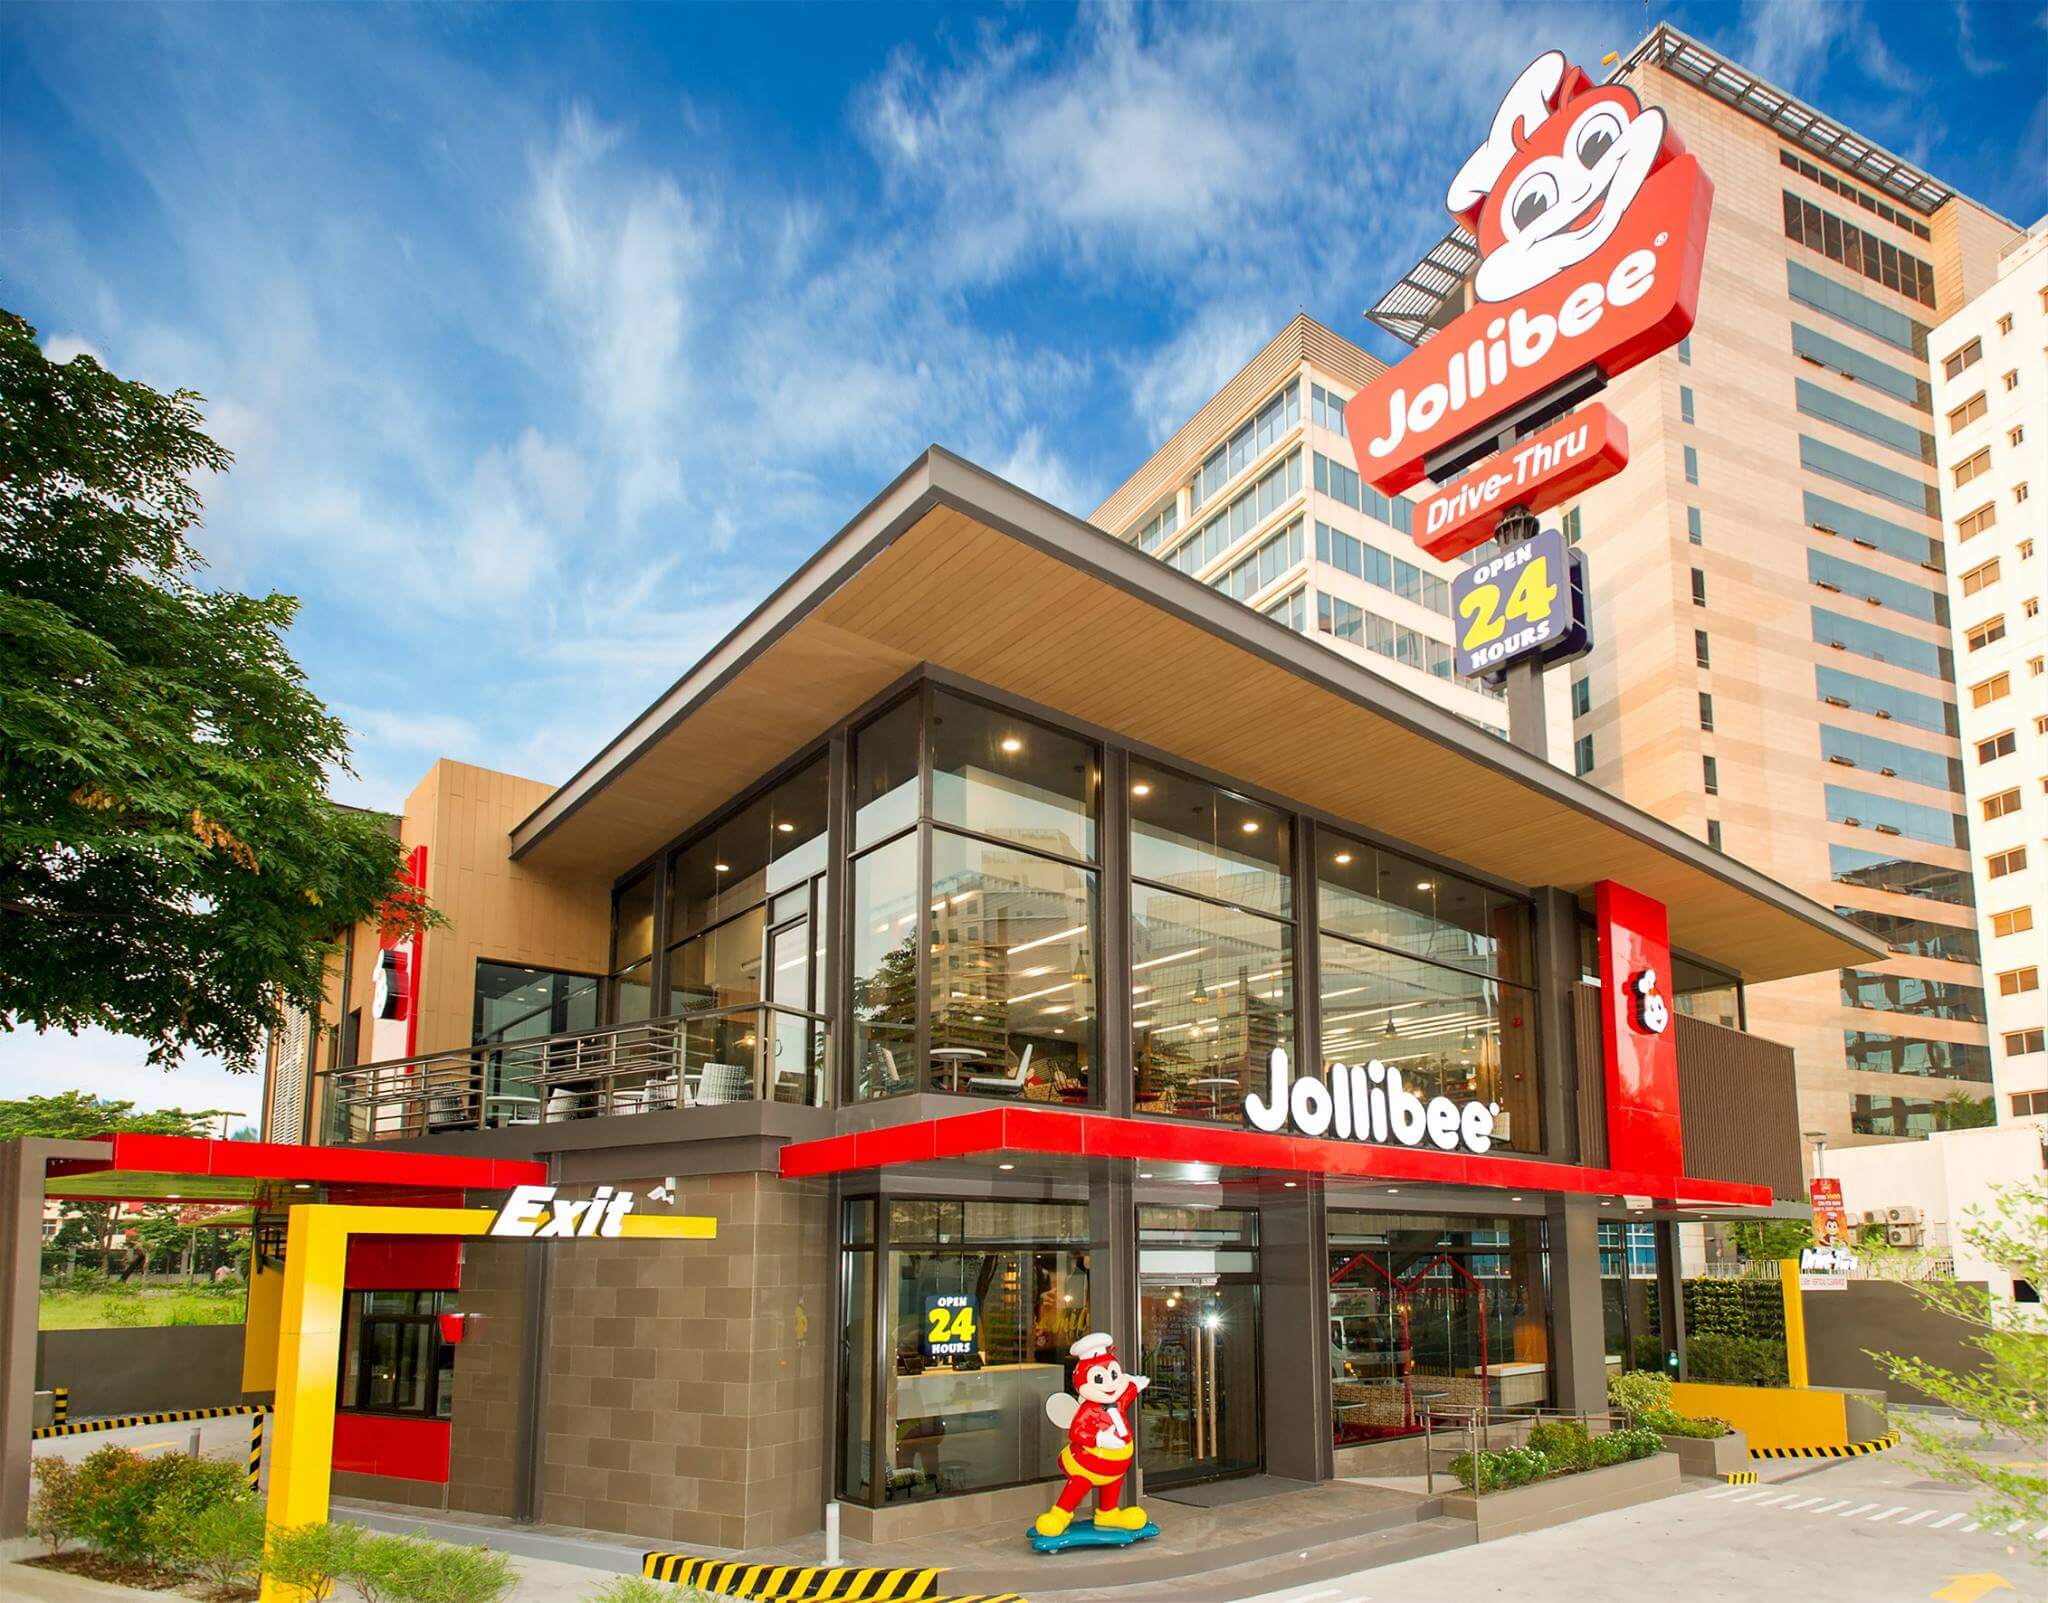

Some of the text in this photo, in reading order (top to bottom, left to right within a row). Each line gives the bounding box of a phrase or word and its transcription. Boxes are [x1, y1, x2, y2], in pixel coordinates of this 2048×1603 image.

[1368, 248, 1657, 458] Jollibee
[1426, 424, 1588, 535] Drive-Thru
[1473, 543, 1533, 585] OPEN
[1459, 555, 1558, 651] 24
[1471, 620, 1551, 669] HOURS
[1244, 1047, 1494, 1154] Jollibee
[490, 1184, 635, 1238] Exit
[928, 1307, 976, 1343] 24
[937, 1296, 968, 1307] OPEN
[931, 1343, 971, 1354] HOURS
